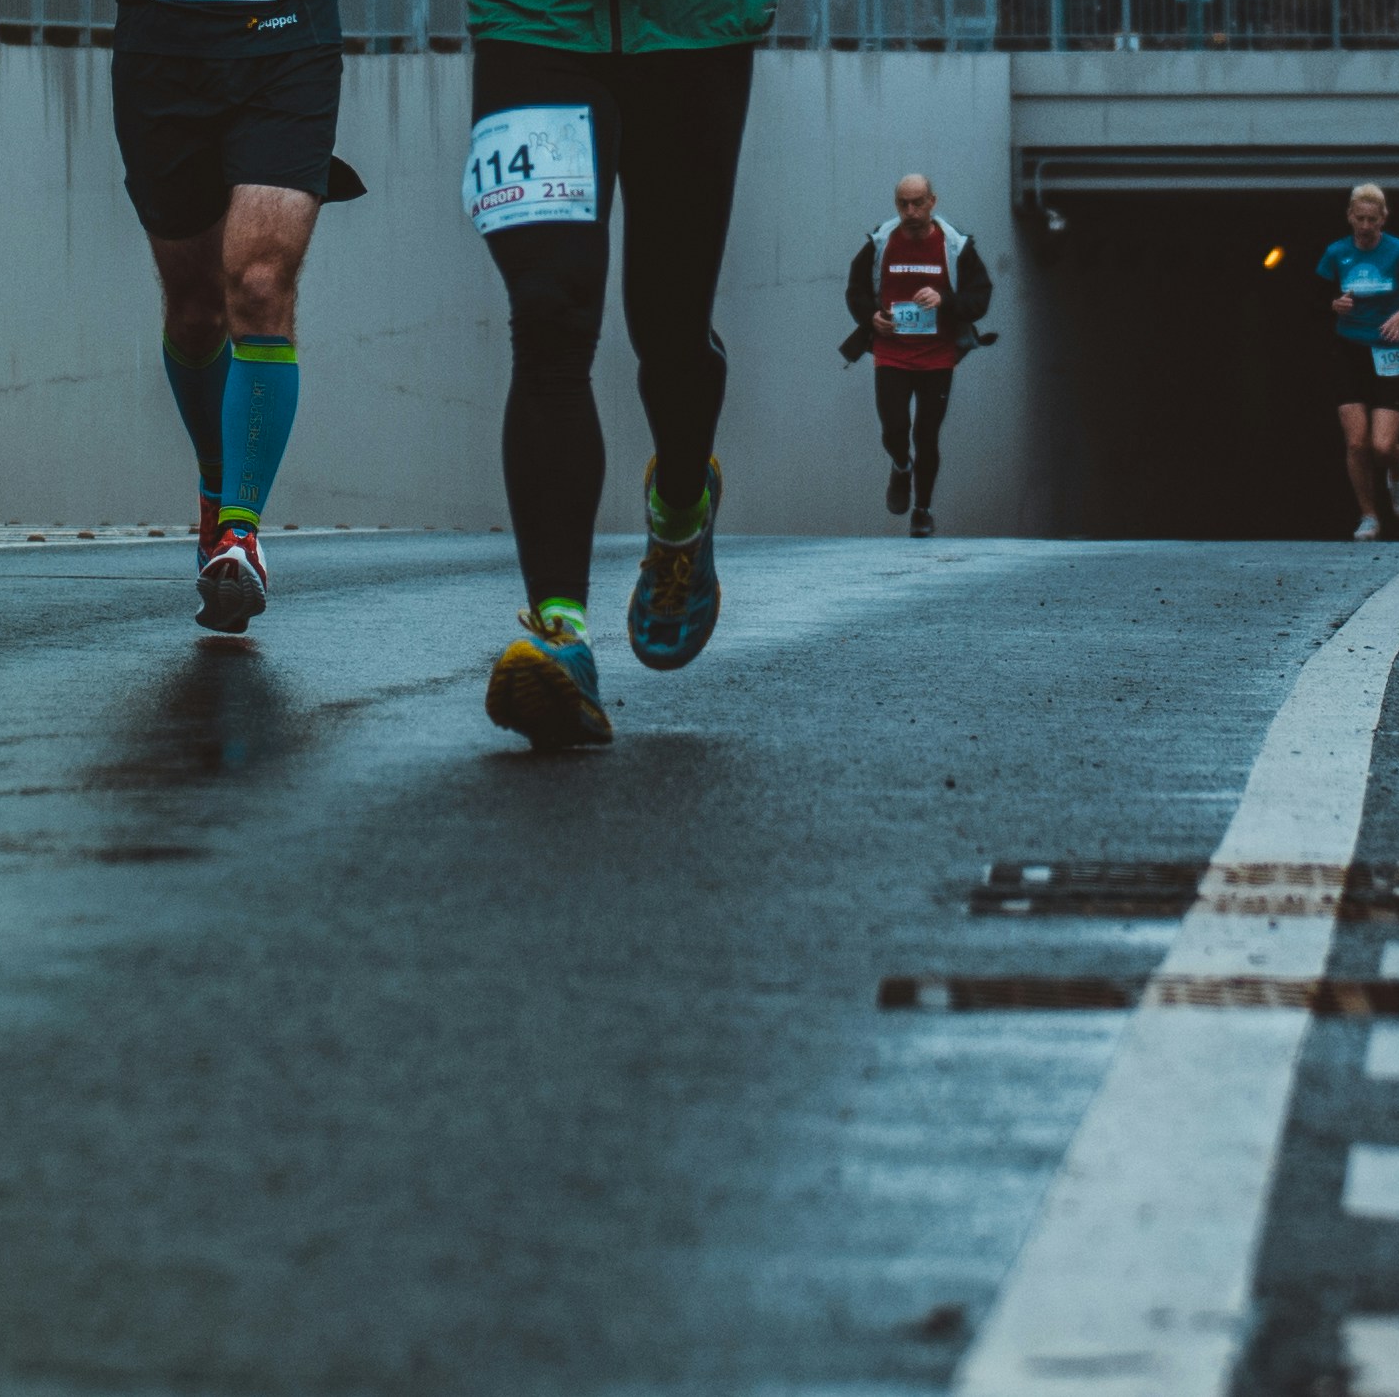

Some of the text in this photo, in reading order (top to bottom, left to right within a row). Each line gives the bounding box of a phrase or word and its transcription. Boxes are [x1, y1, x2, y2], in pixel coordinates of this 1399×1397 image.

[257, 13, 298, 31] puppet
[471, 144, 535, 193] 114
[482, 186, 522, 209] PROFI
[899, 310, 920, 322] 131
